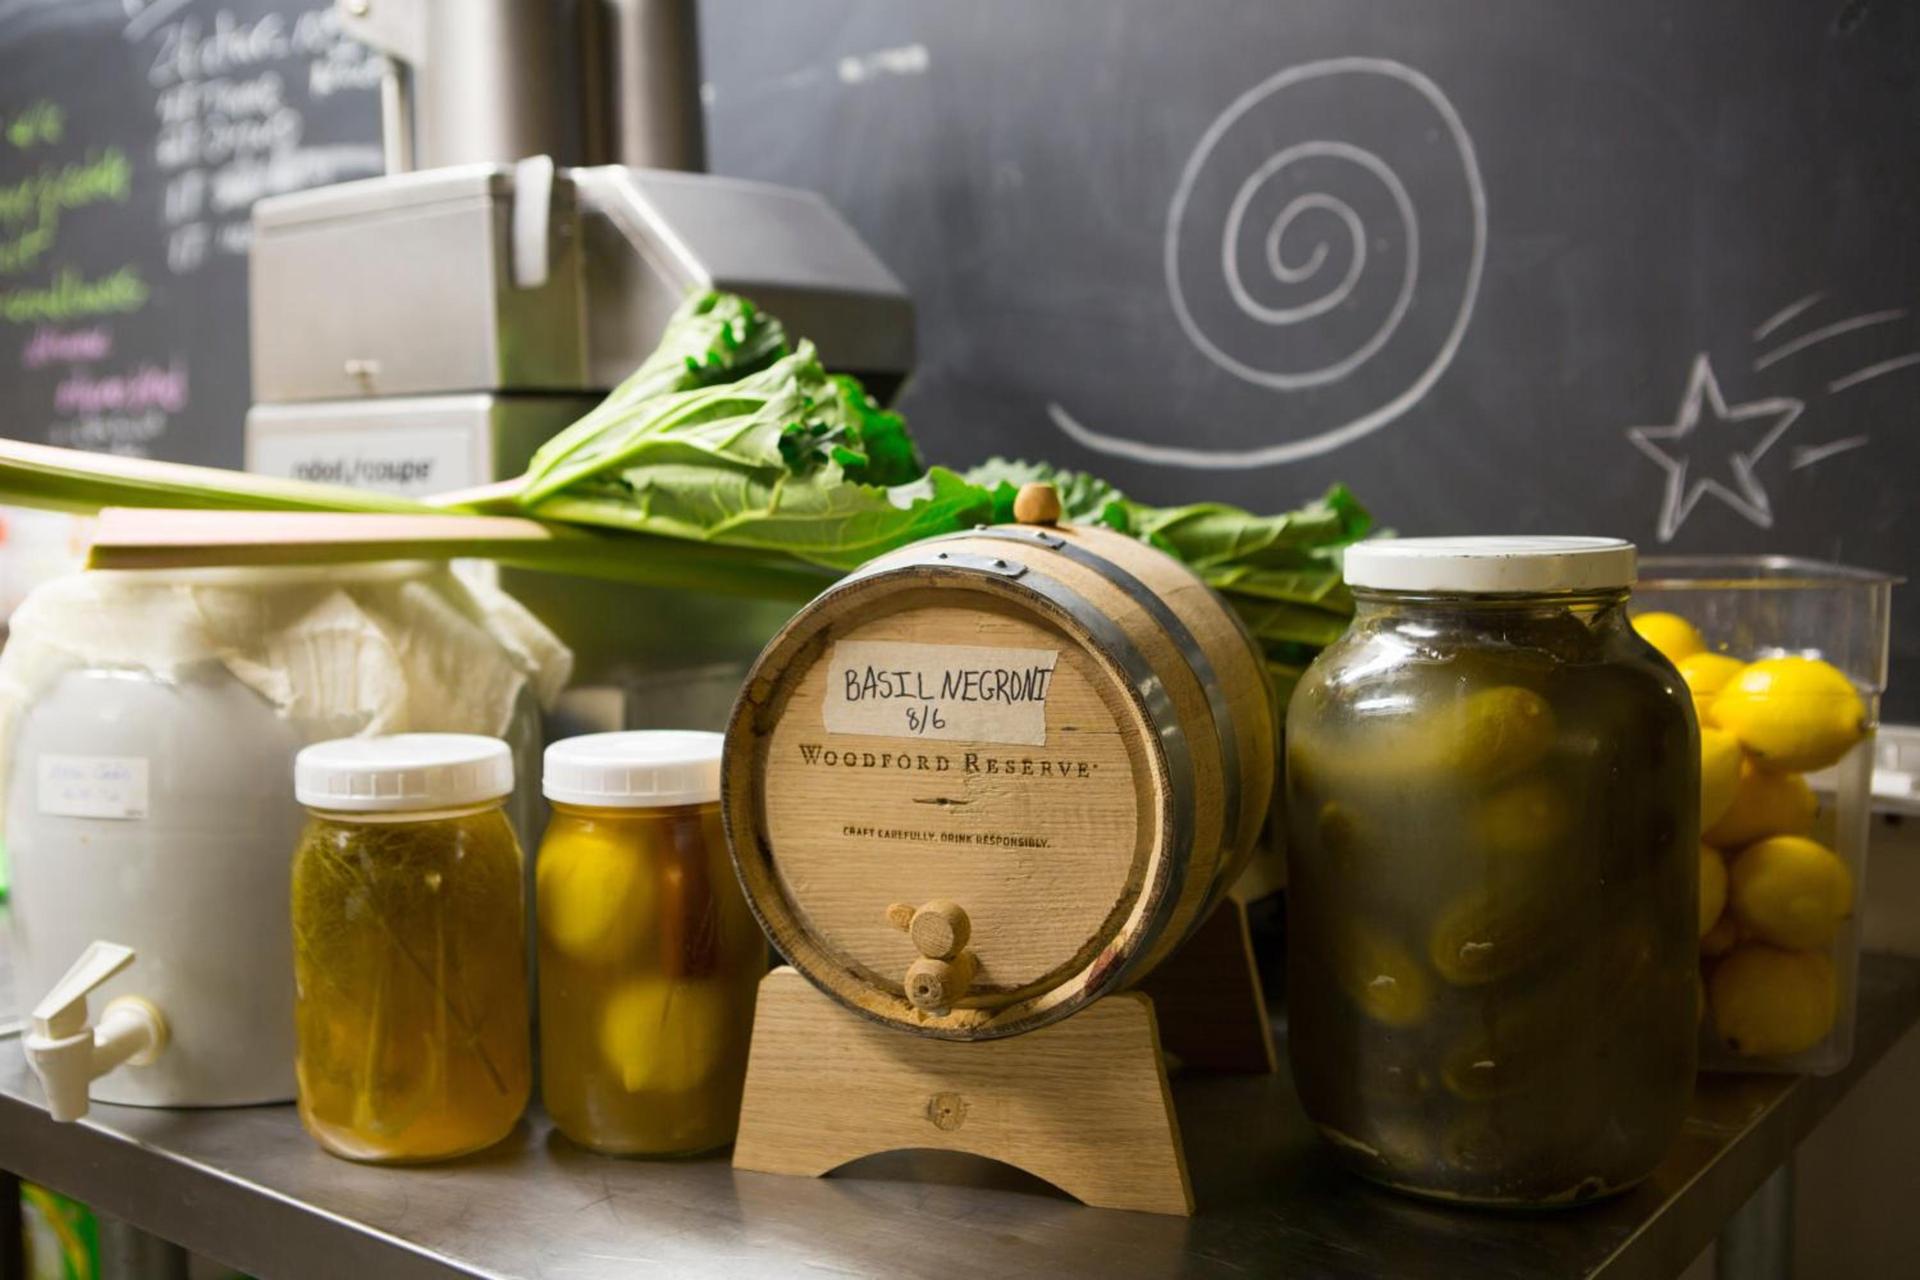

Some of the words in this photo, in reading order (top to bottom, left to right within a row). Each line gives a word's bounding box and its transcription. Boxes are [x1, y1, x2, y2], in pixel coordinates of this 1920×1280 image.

[844, 665, 935, 702] BASIL
[940, 666, 1054, 705] NEGRONI
[905, 705, 946, 734] 8/6
[842, 826, 875, 838] CRAFT
[877, 829, 938, 843] CAREFULLY.
[940, 833, 973, 845] DRINK
[975, 834, 1052, 849] RESPONSIBLY.
